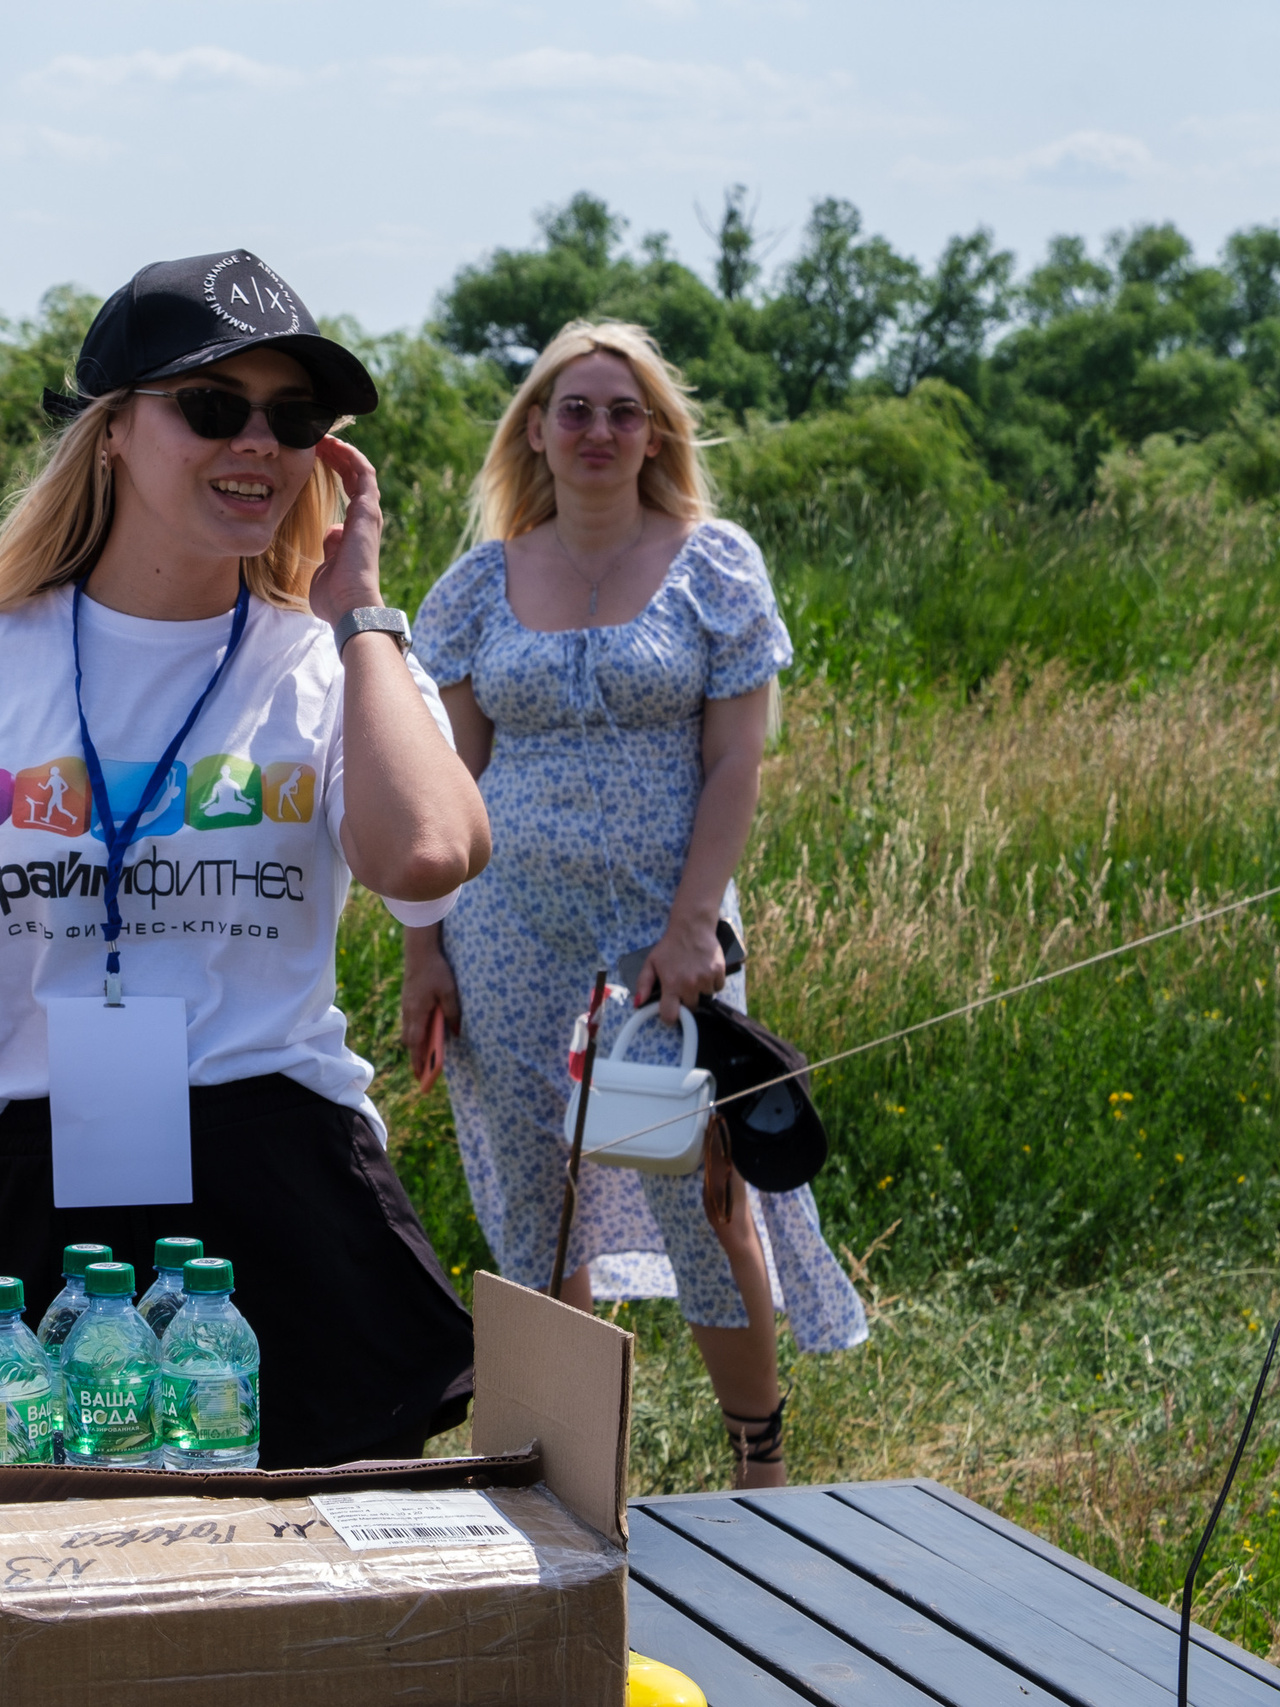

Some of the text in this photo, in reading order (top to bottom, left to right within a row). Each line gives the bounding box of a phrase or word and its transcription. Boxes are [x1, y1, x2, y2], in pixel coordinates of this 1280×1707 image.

[203, 255, 256, 334] ARMANI EXCHANGE
[66, 920, 279, 939] ФИНЕС-КЛУБОВ
[80, 1390, 137, 1408] ВАША
[81, 1408, 138, 1425] ВОДА
[83, 1425, 140, 1433] ГАЗИРОВАННАЯ
